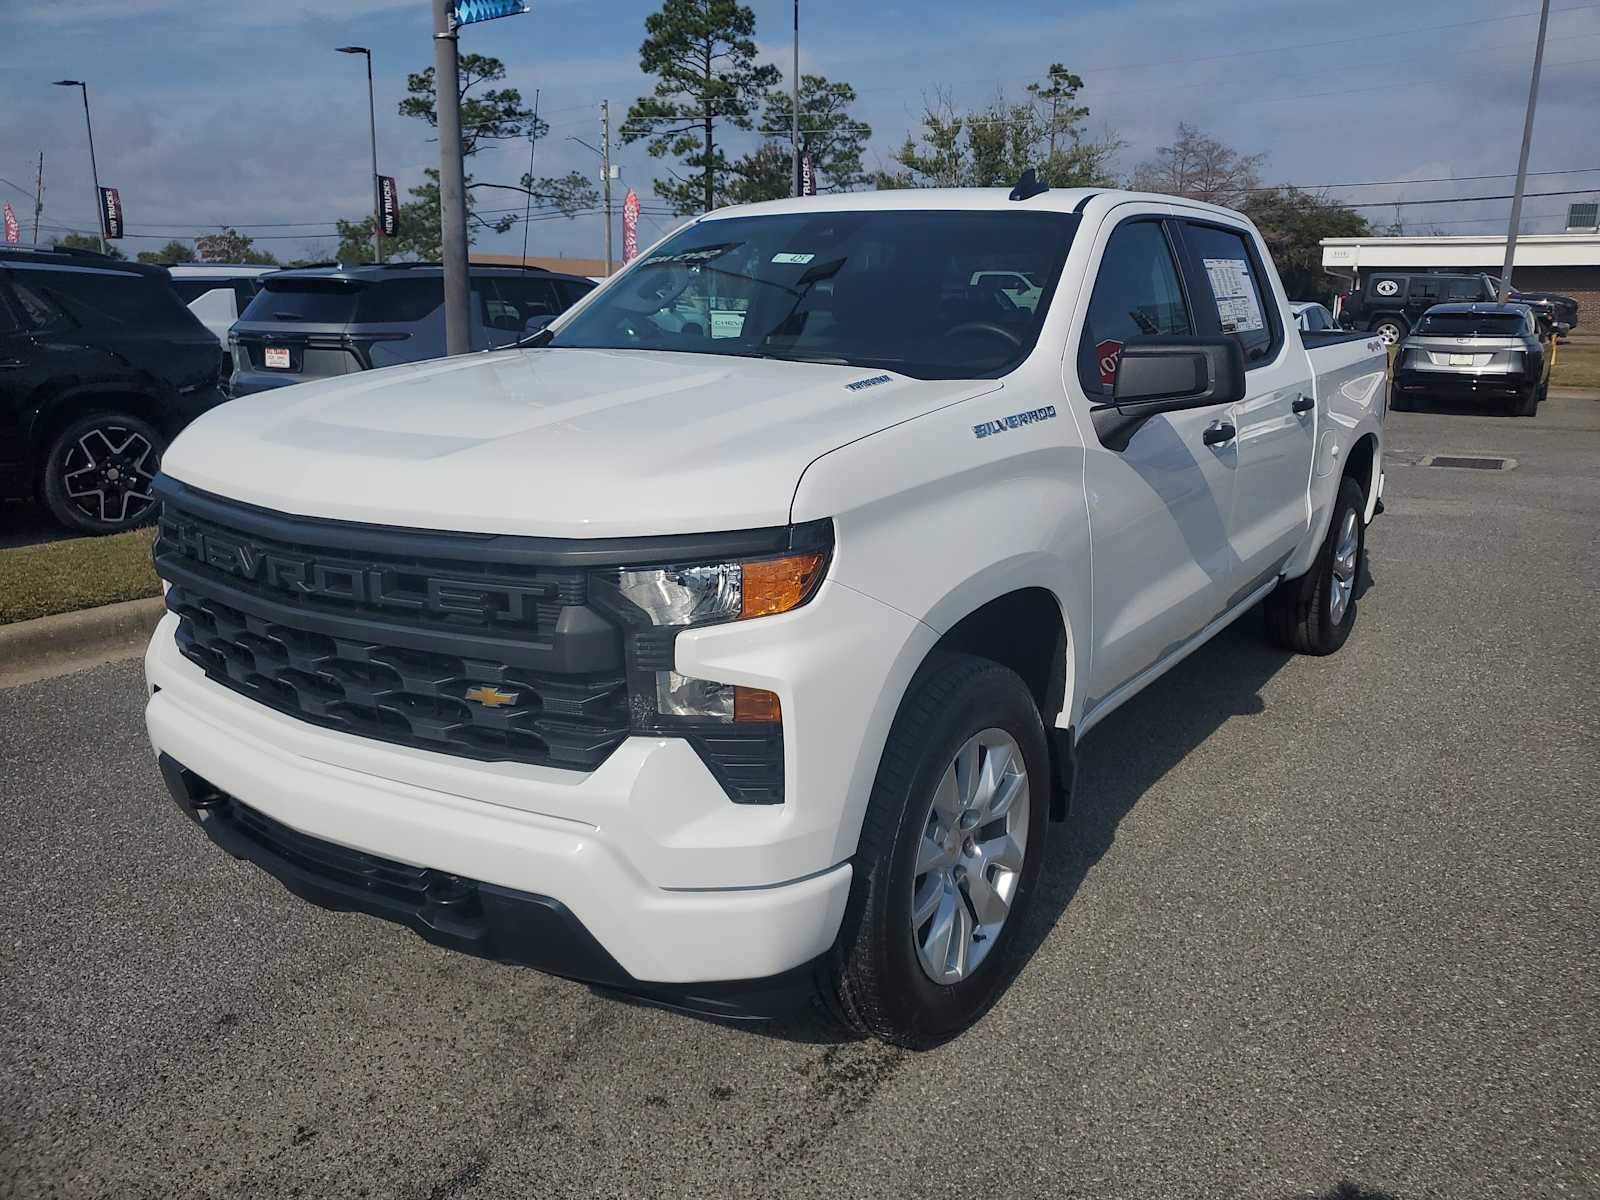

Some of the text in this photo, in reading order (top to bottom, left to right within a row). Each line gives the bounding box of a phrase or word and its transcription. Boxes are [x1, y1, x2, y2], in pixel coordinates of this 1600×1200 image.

[105, 190, 116, 219] TRUCKS
[382, 180, 393, 234] NEW TRUCKS
[973, 405, 1057, 439] SILVERADO
[159, 517, 551, 622] CHEVROLET
